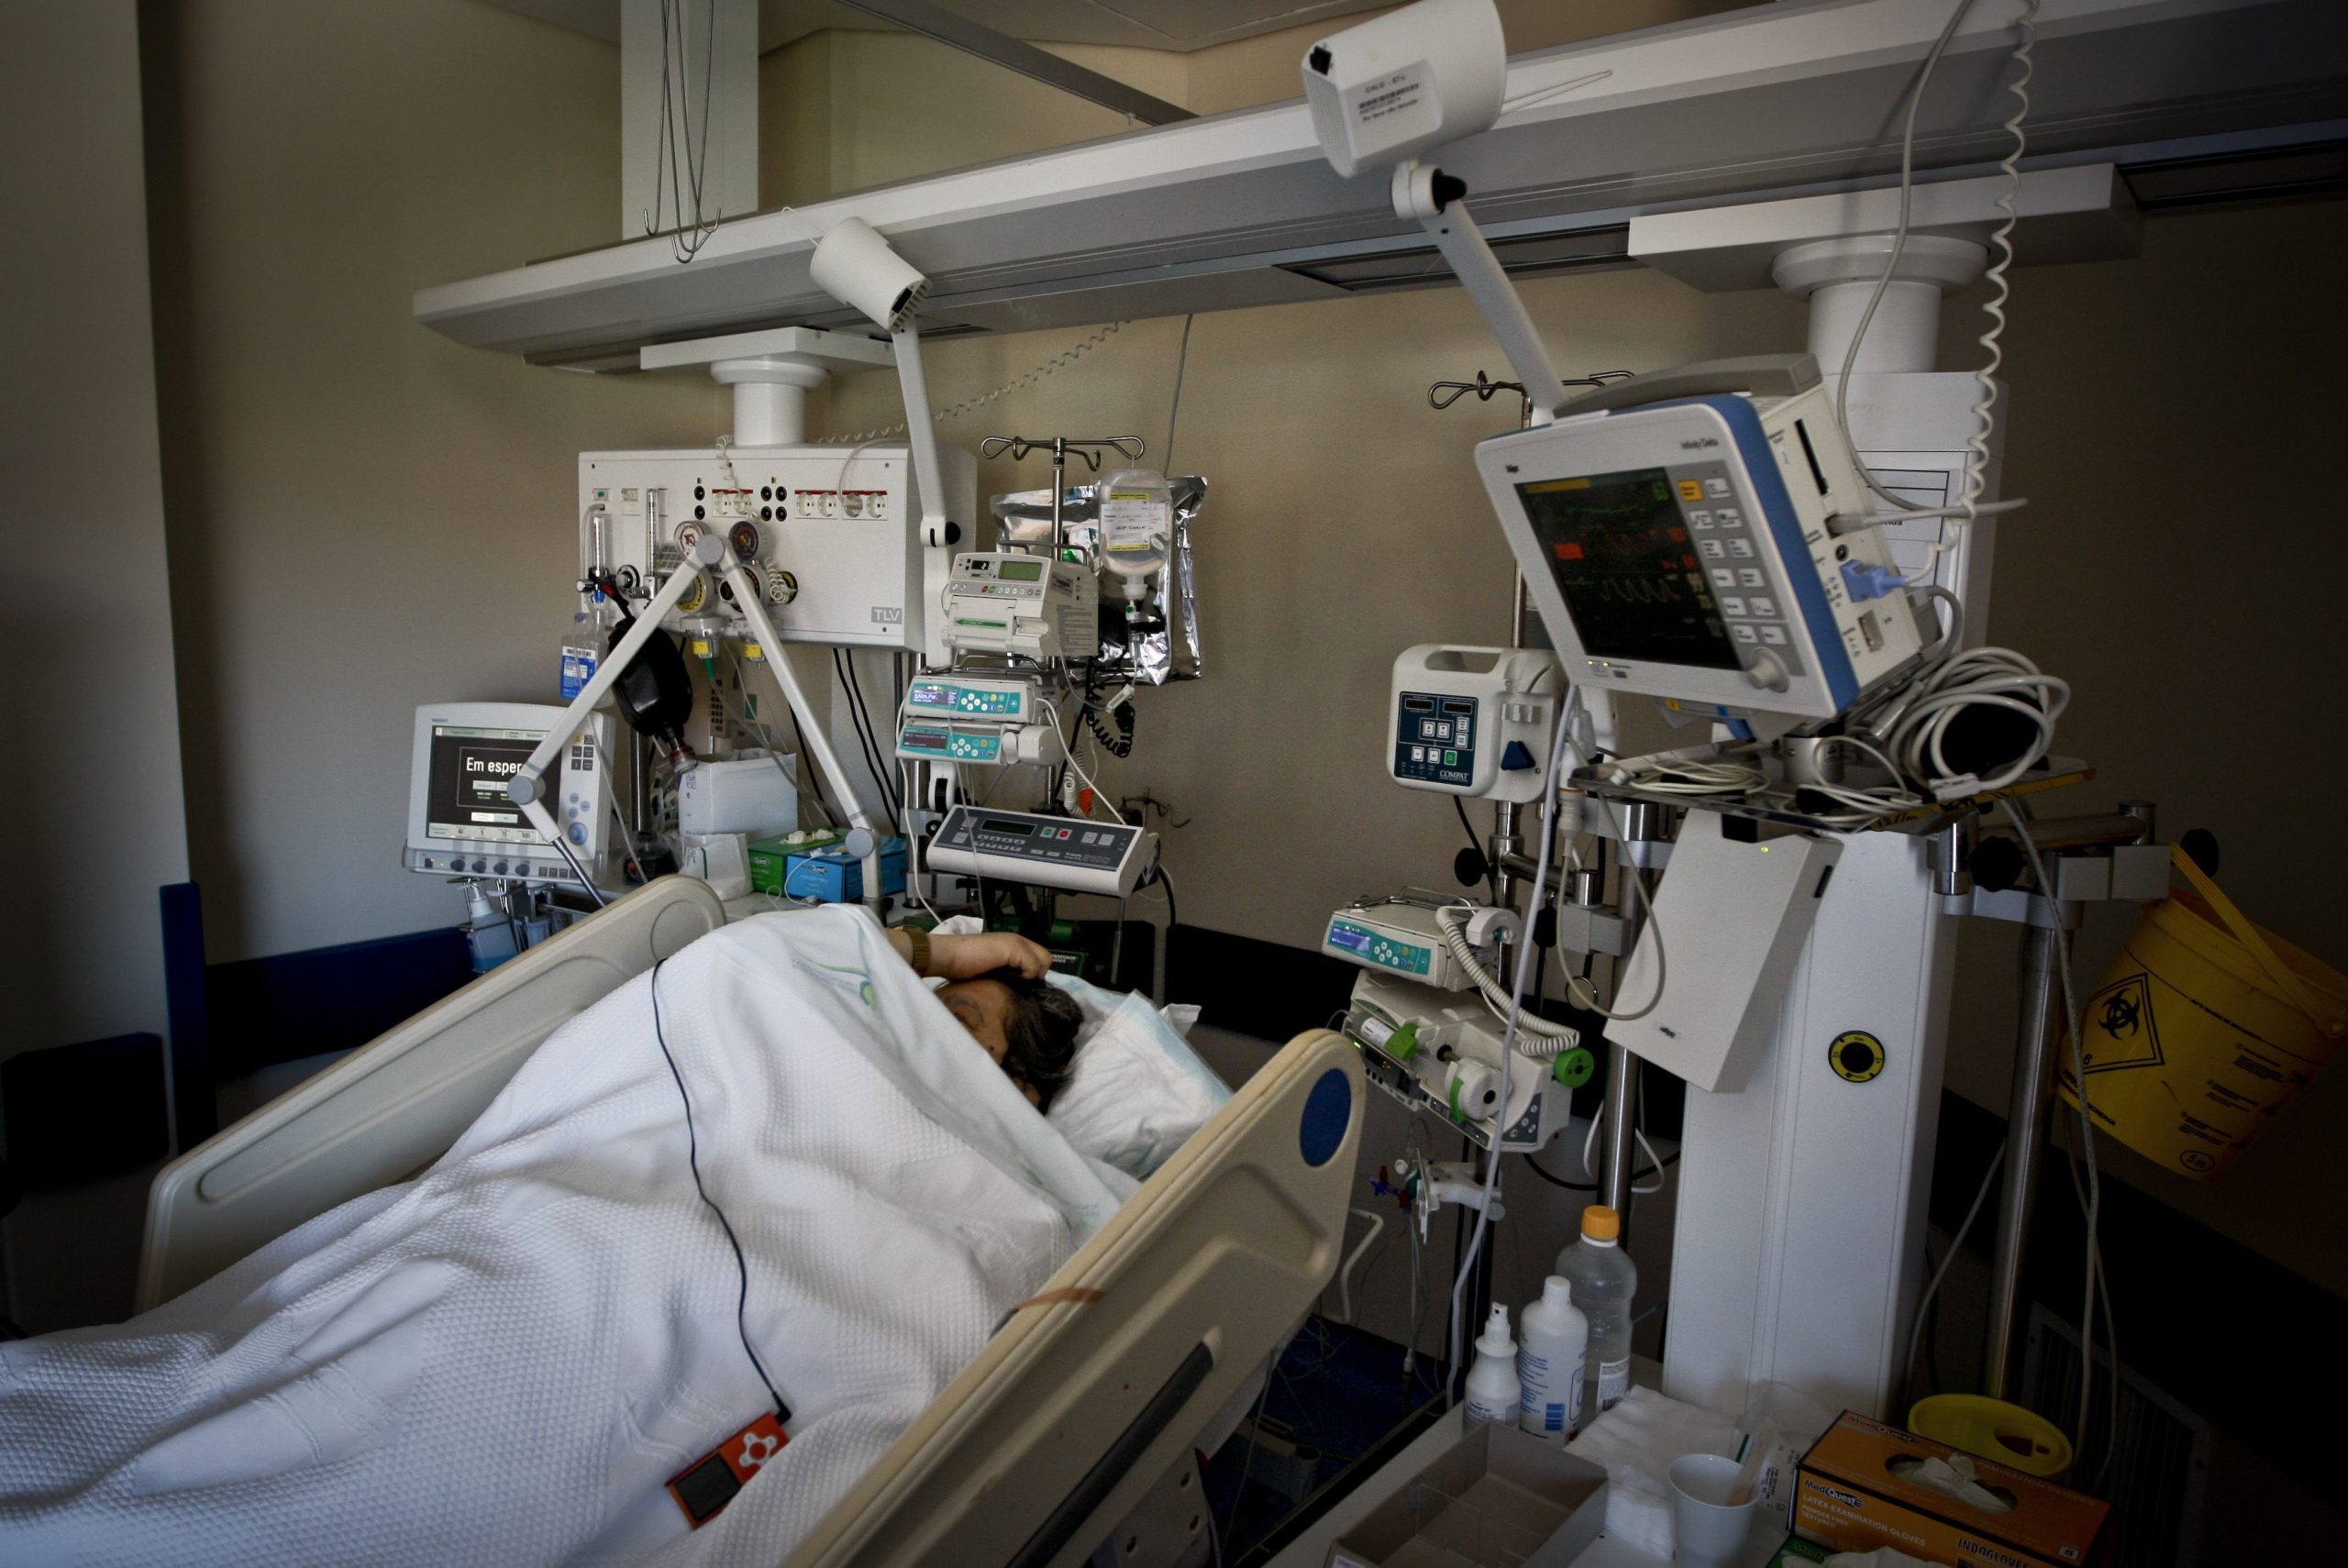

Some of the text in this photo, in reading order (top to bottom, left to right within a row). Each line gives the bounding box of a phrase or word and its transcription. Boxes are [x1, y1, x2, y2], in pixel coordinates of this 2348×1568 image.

[873, 608, 901, 622] TLV
[465, 756, 523, 776] Em esper
[1439, 769, 1468, 780] COMPAT
[1804, 1479, 1860, 1509] MediQuest
[1802, 1494, 1829, 1509] LATEX
[1830, 1500, 1888, 1533] EXAMINATION
[1889, 1527, 1926, 1548] GLOVES
